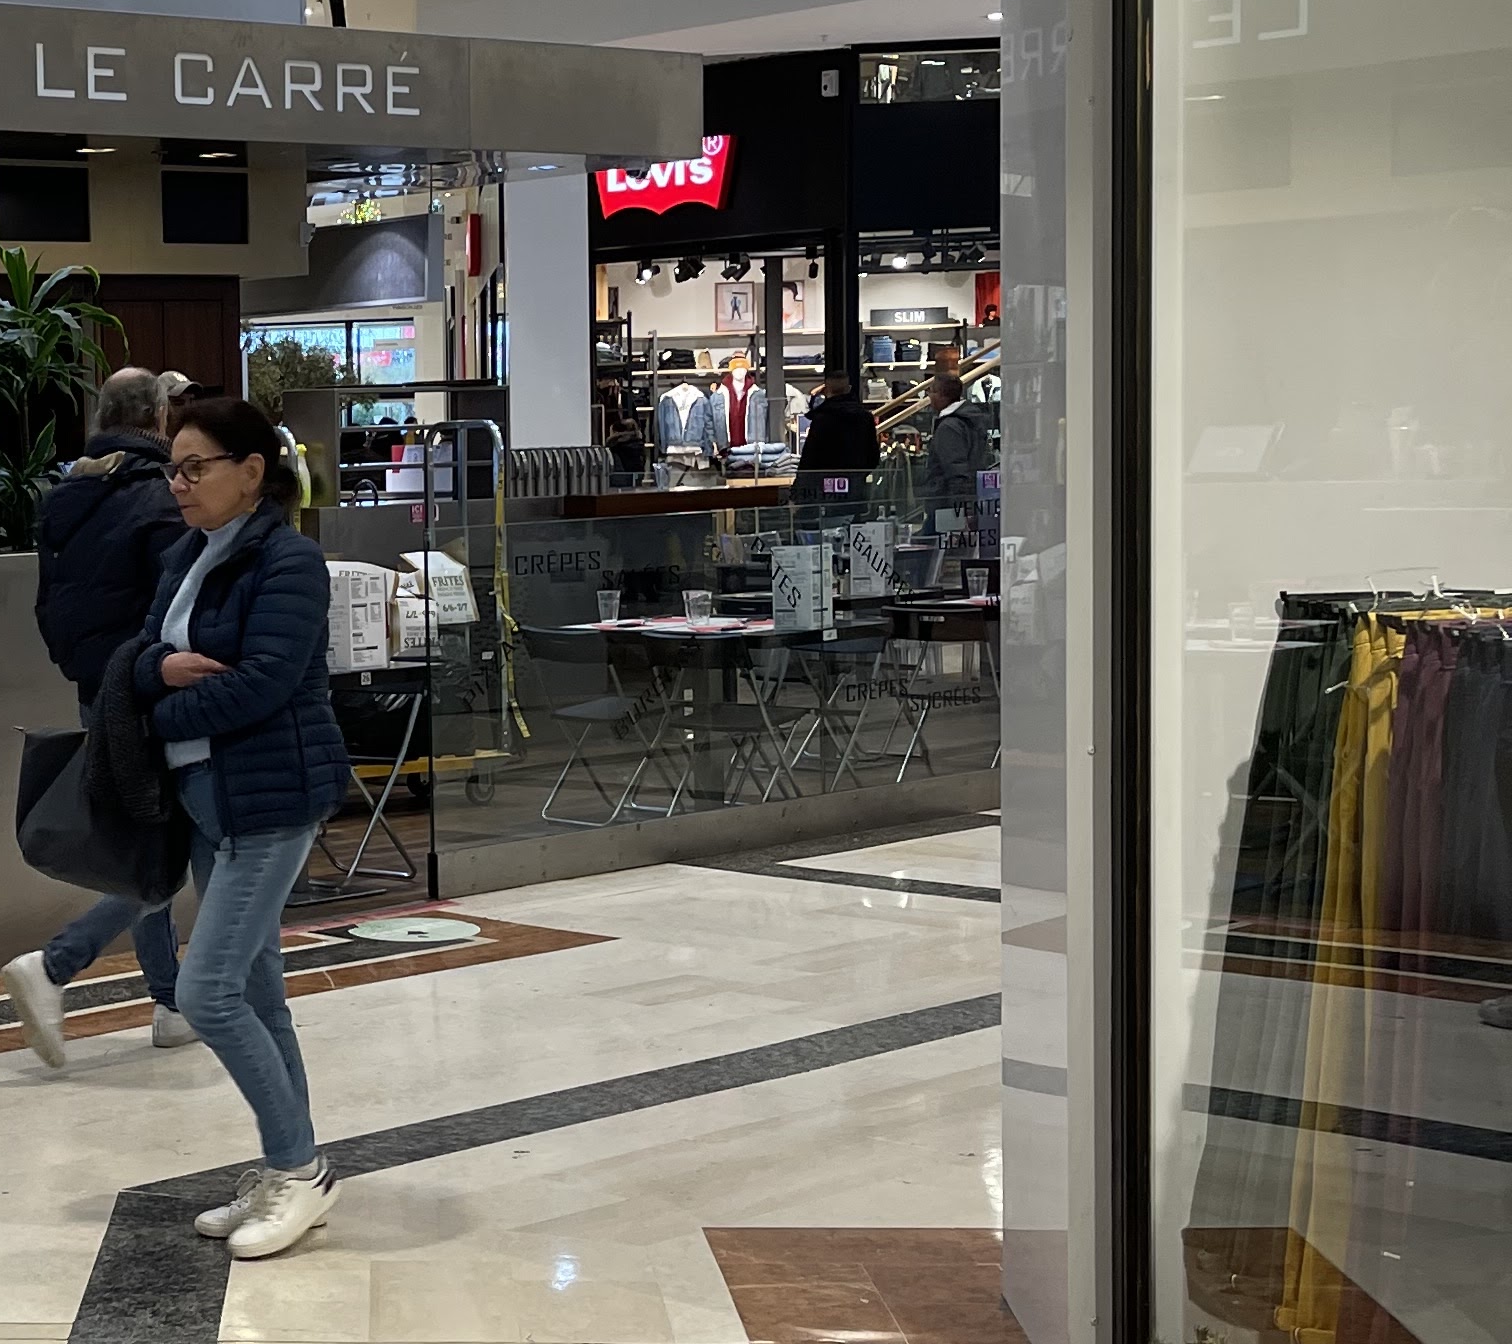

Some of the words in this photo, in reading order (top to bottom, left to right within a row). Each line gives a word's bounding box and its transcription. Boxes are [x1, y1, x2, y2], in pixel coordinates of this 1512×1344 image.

[36, 42, 128, 101] LE
[174, 50, 421, 116] CARRÉ
[894, 310, 925, 324] SLIM
[938, 528, 997, 551] GLACES
[514, 550, 601, 576] CRÊPES
[432, 575, 465, 587] FRITES
[846, 677, 908, 703] CRÊPES
[910, 683, 981, 713] SUCRÉES
